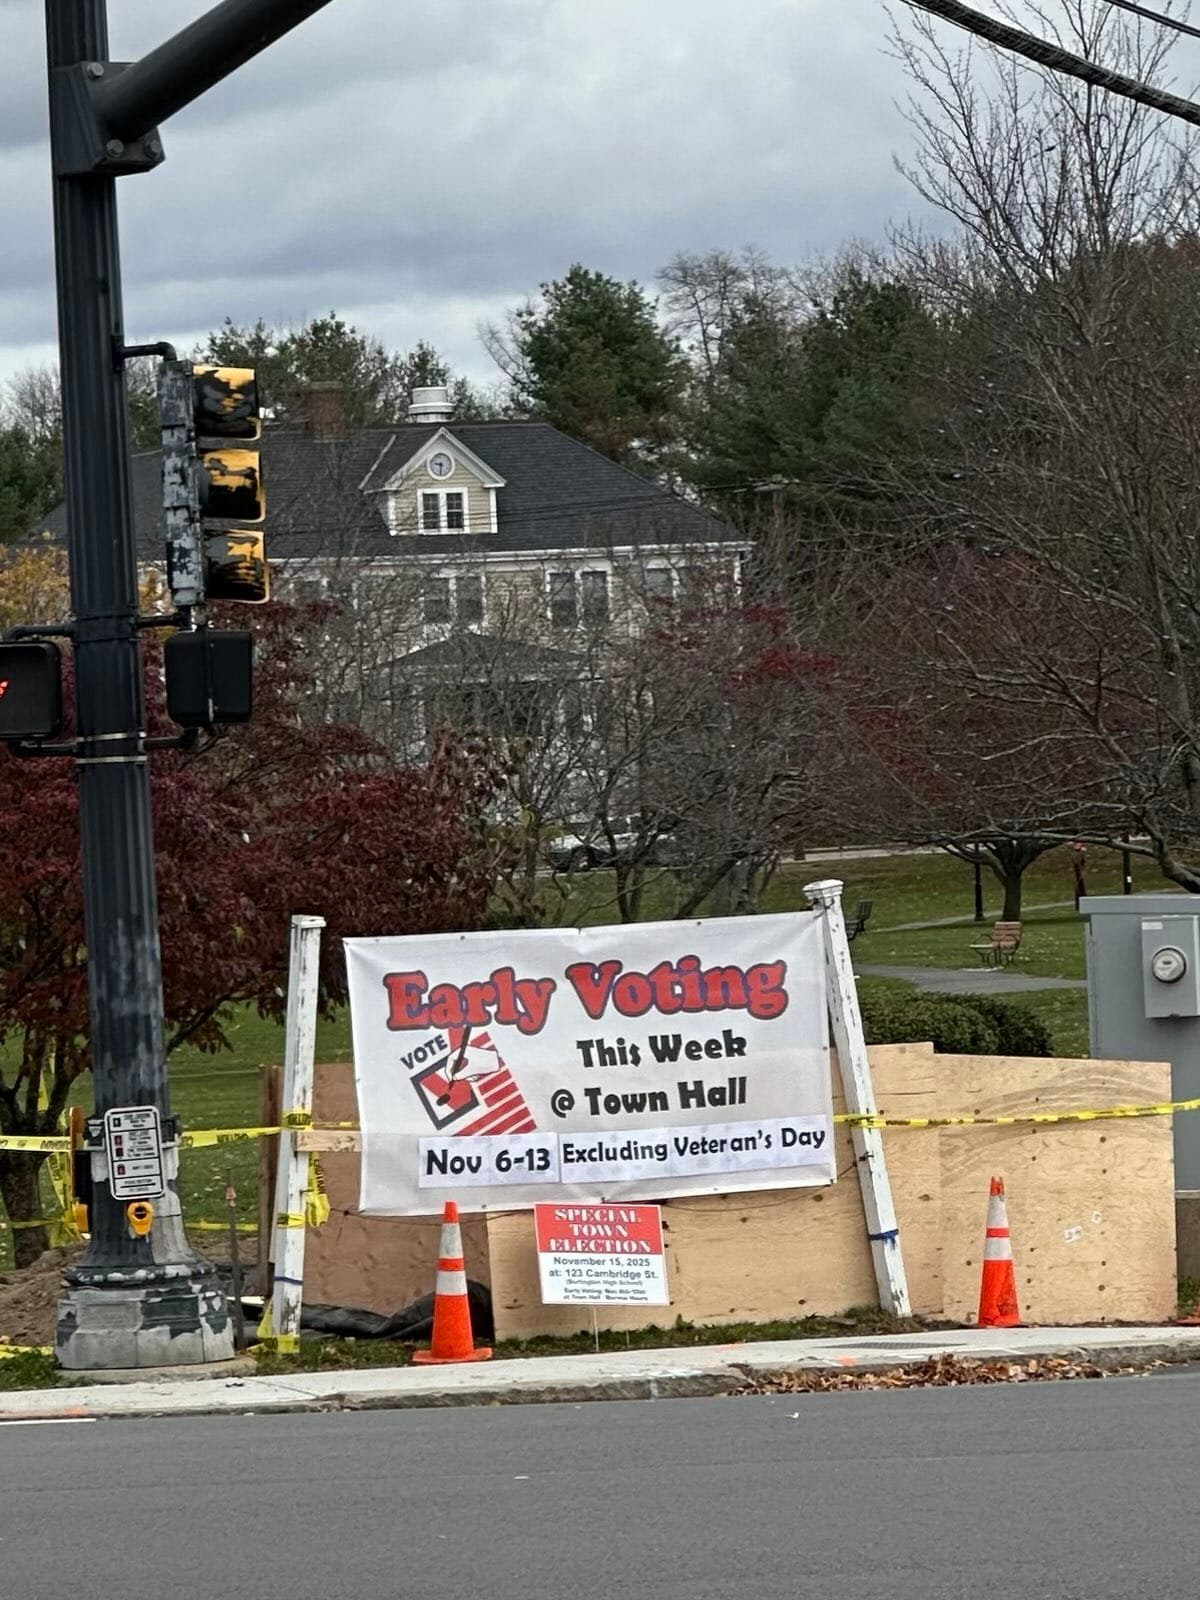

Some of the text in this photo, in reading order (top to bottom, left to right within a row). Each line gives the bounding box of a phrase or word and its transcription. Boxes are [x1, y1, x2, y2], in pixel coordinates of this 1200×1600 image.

[383, 955, 788, 1036] Early Voting
[400, 1034, 449, 1070] VOTE
[577, 1029, 747, 1068] This Week
[551, 1076, 747, 1118] @ Town Hall
[426, 1127, 825, 1175] Nov 6-13 Excluding Veteran's Day
[554, 1208, 641, 1223] SPECIAL
[569, 1223, 628, 1237] TOWN
[549, 1238, 651, 1253] ELECTION
[554, 1257, 650, 1267] November 15, 2025
[565, 1269, 583, 1278] 123
[586, 1269, 641, 1280] Cambridge
[645, 1270, 659, 1279] St.
